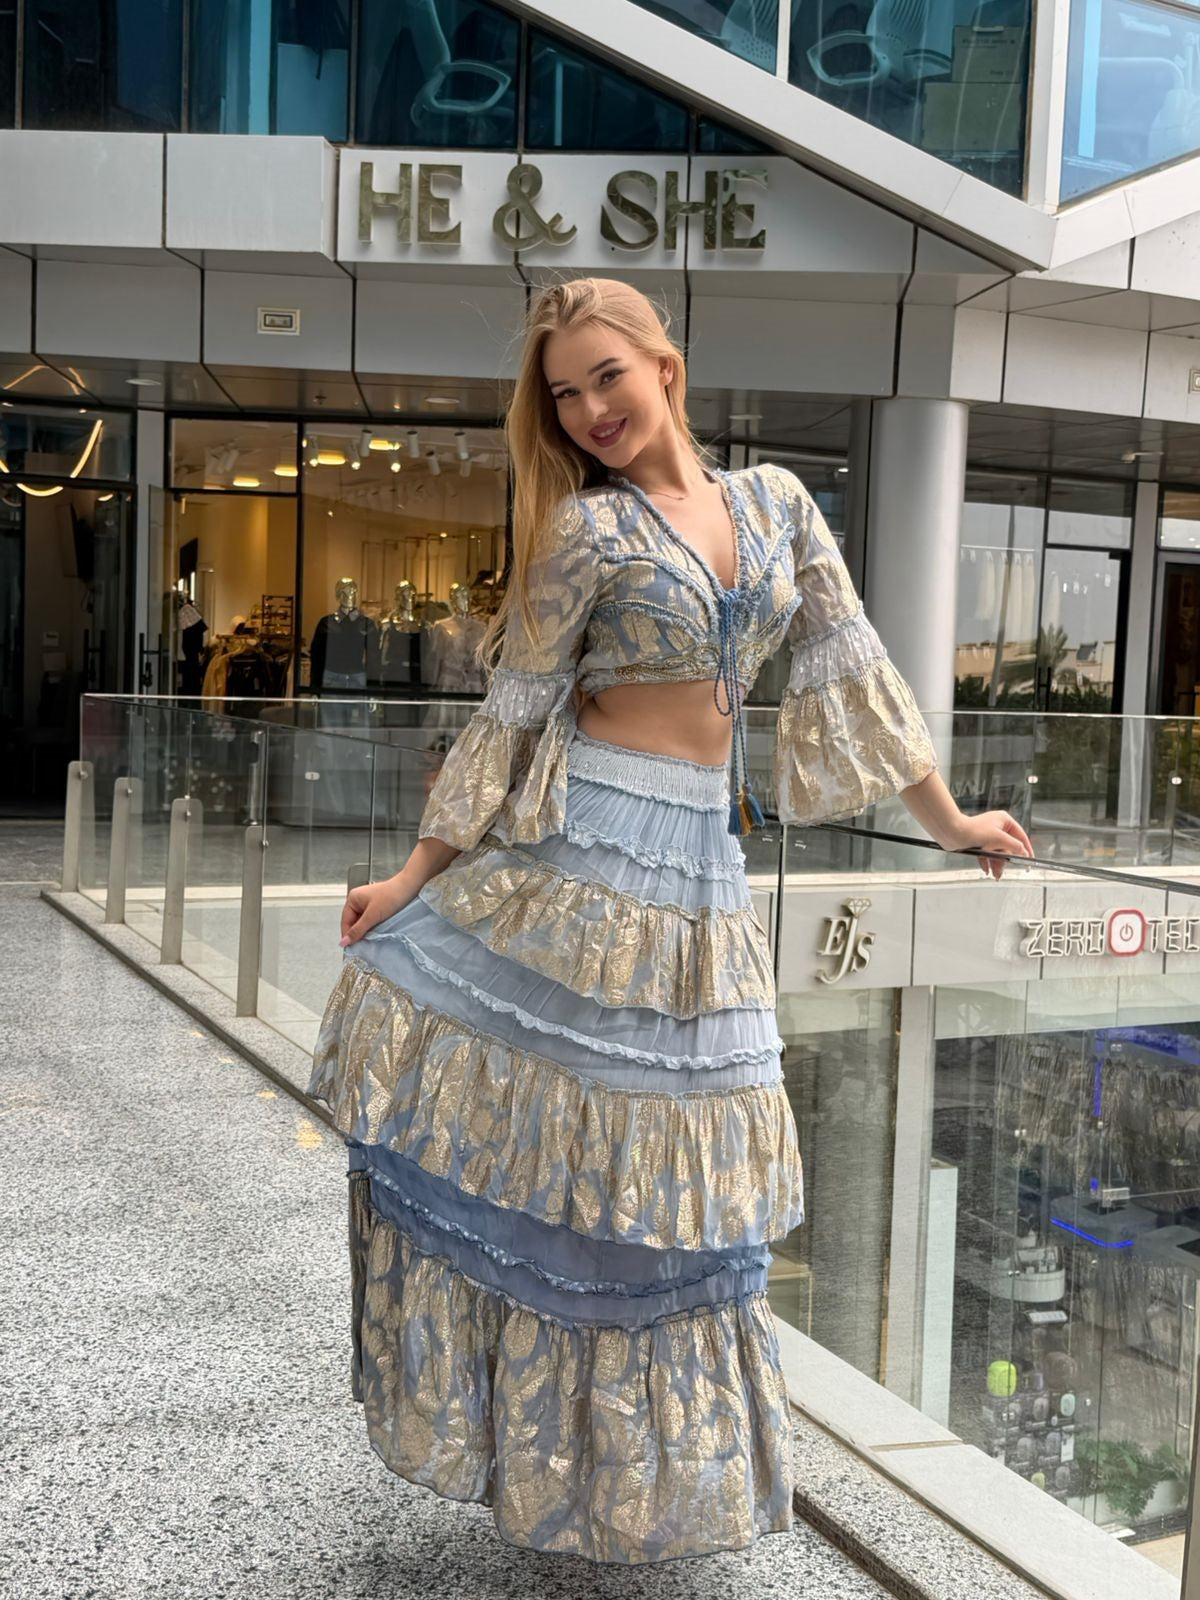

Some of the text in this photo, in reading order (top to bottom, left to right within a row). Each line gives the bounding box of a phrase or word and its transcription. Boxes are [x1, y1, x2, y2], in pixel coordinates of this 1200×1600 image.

[359, 162, 768, 252] HE & SHE
[1020, 918, 1105, 957] ZERO
